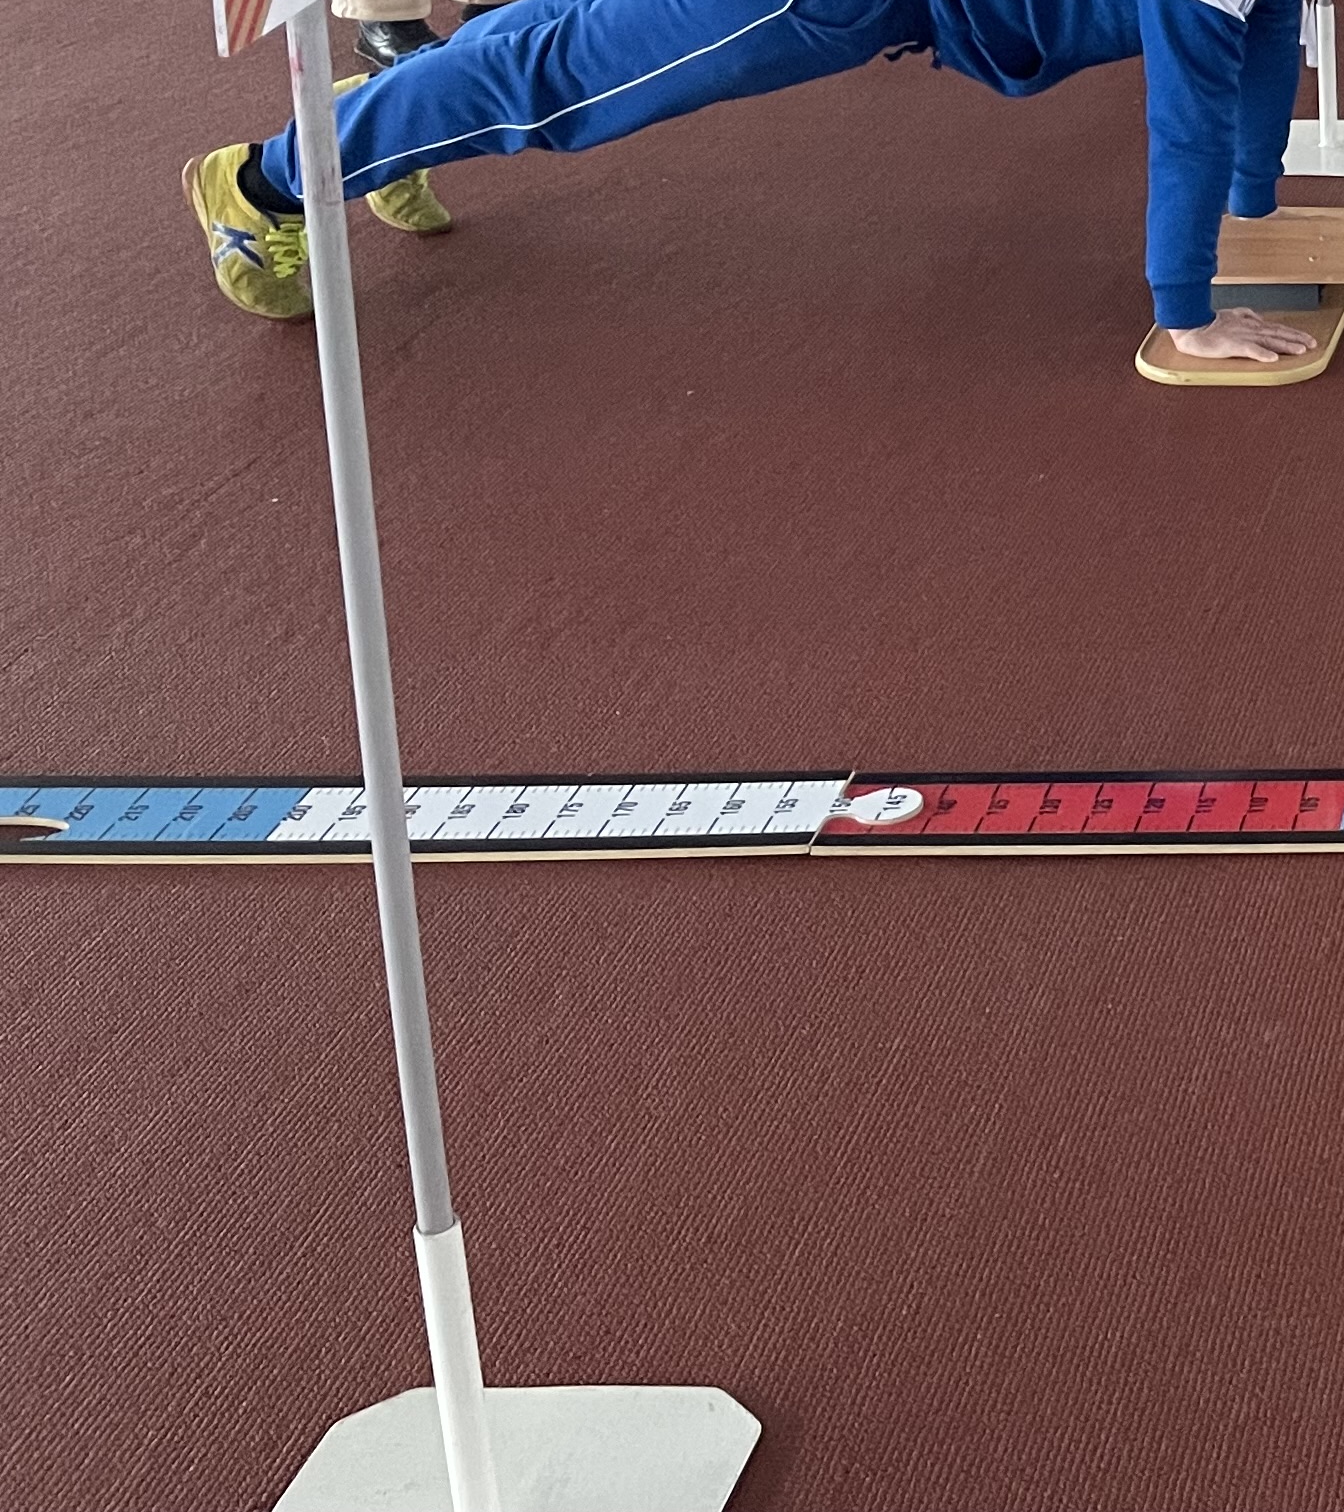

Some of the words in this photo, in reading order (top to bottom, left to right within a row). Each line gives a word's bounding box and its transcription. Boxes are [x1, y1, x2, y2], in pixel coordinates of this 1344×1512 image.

[448, 803, 475, 819] 185
[502, 803, 529, 819] 180
[557, 802, 584, 818] 175
[612, 801, 638, 817] 170
[665, 800, 692, 816] 165
[720, 799, 745, 815] 160
[774, 798, 799, 814] 155
[883, 795, 907, 811] 145
[1194, 797, 1217, 814] 115
[1246, 797, 1269, 814] 110
[64, 804, 94, 822] 220
[117, 804, 149, 822] 215
[172, 804, 203, 822] 210
[281, 804, 312, 822] 200
[338, 804, 366, 822] 195
